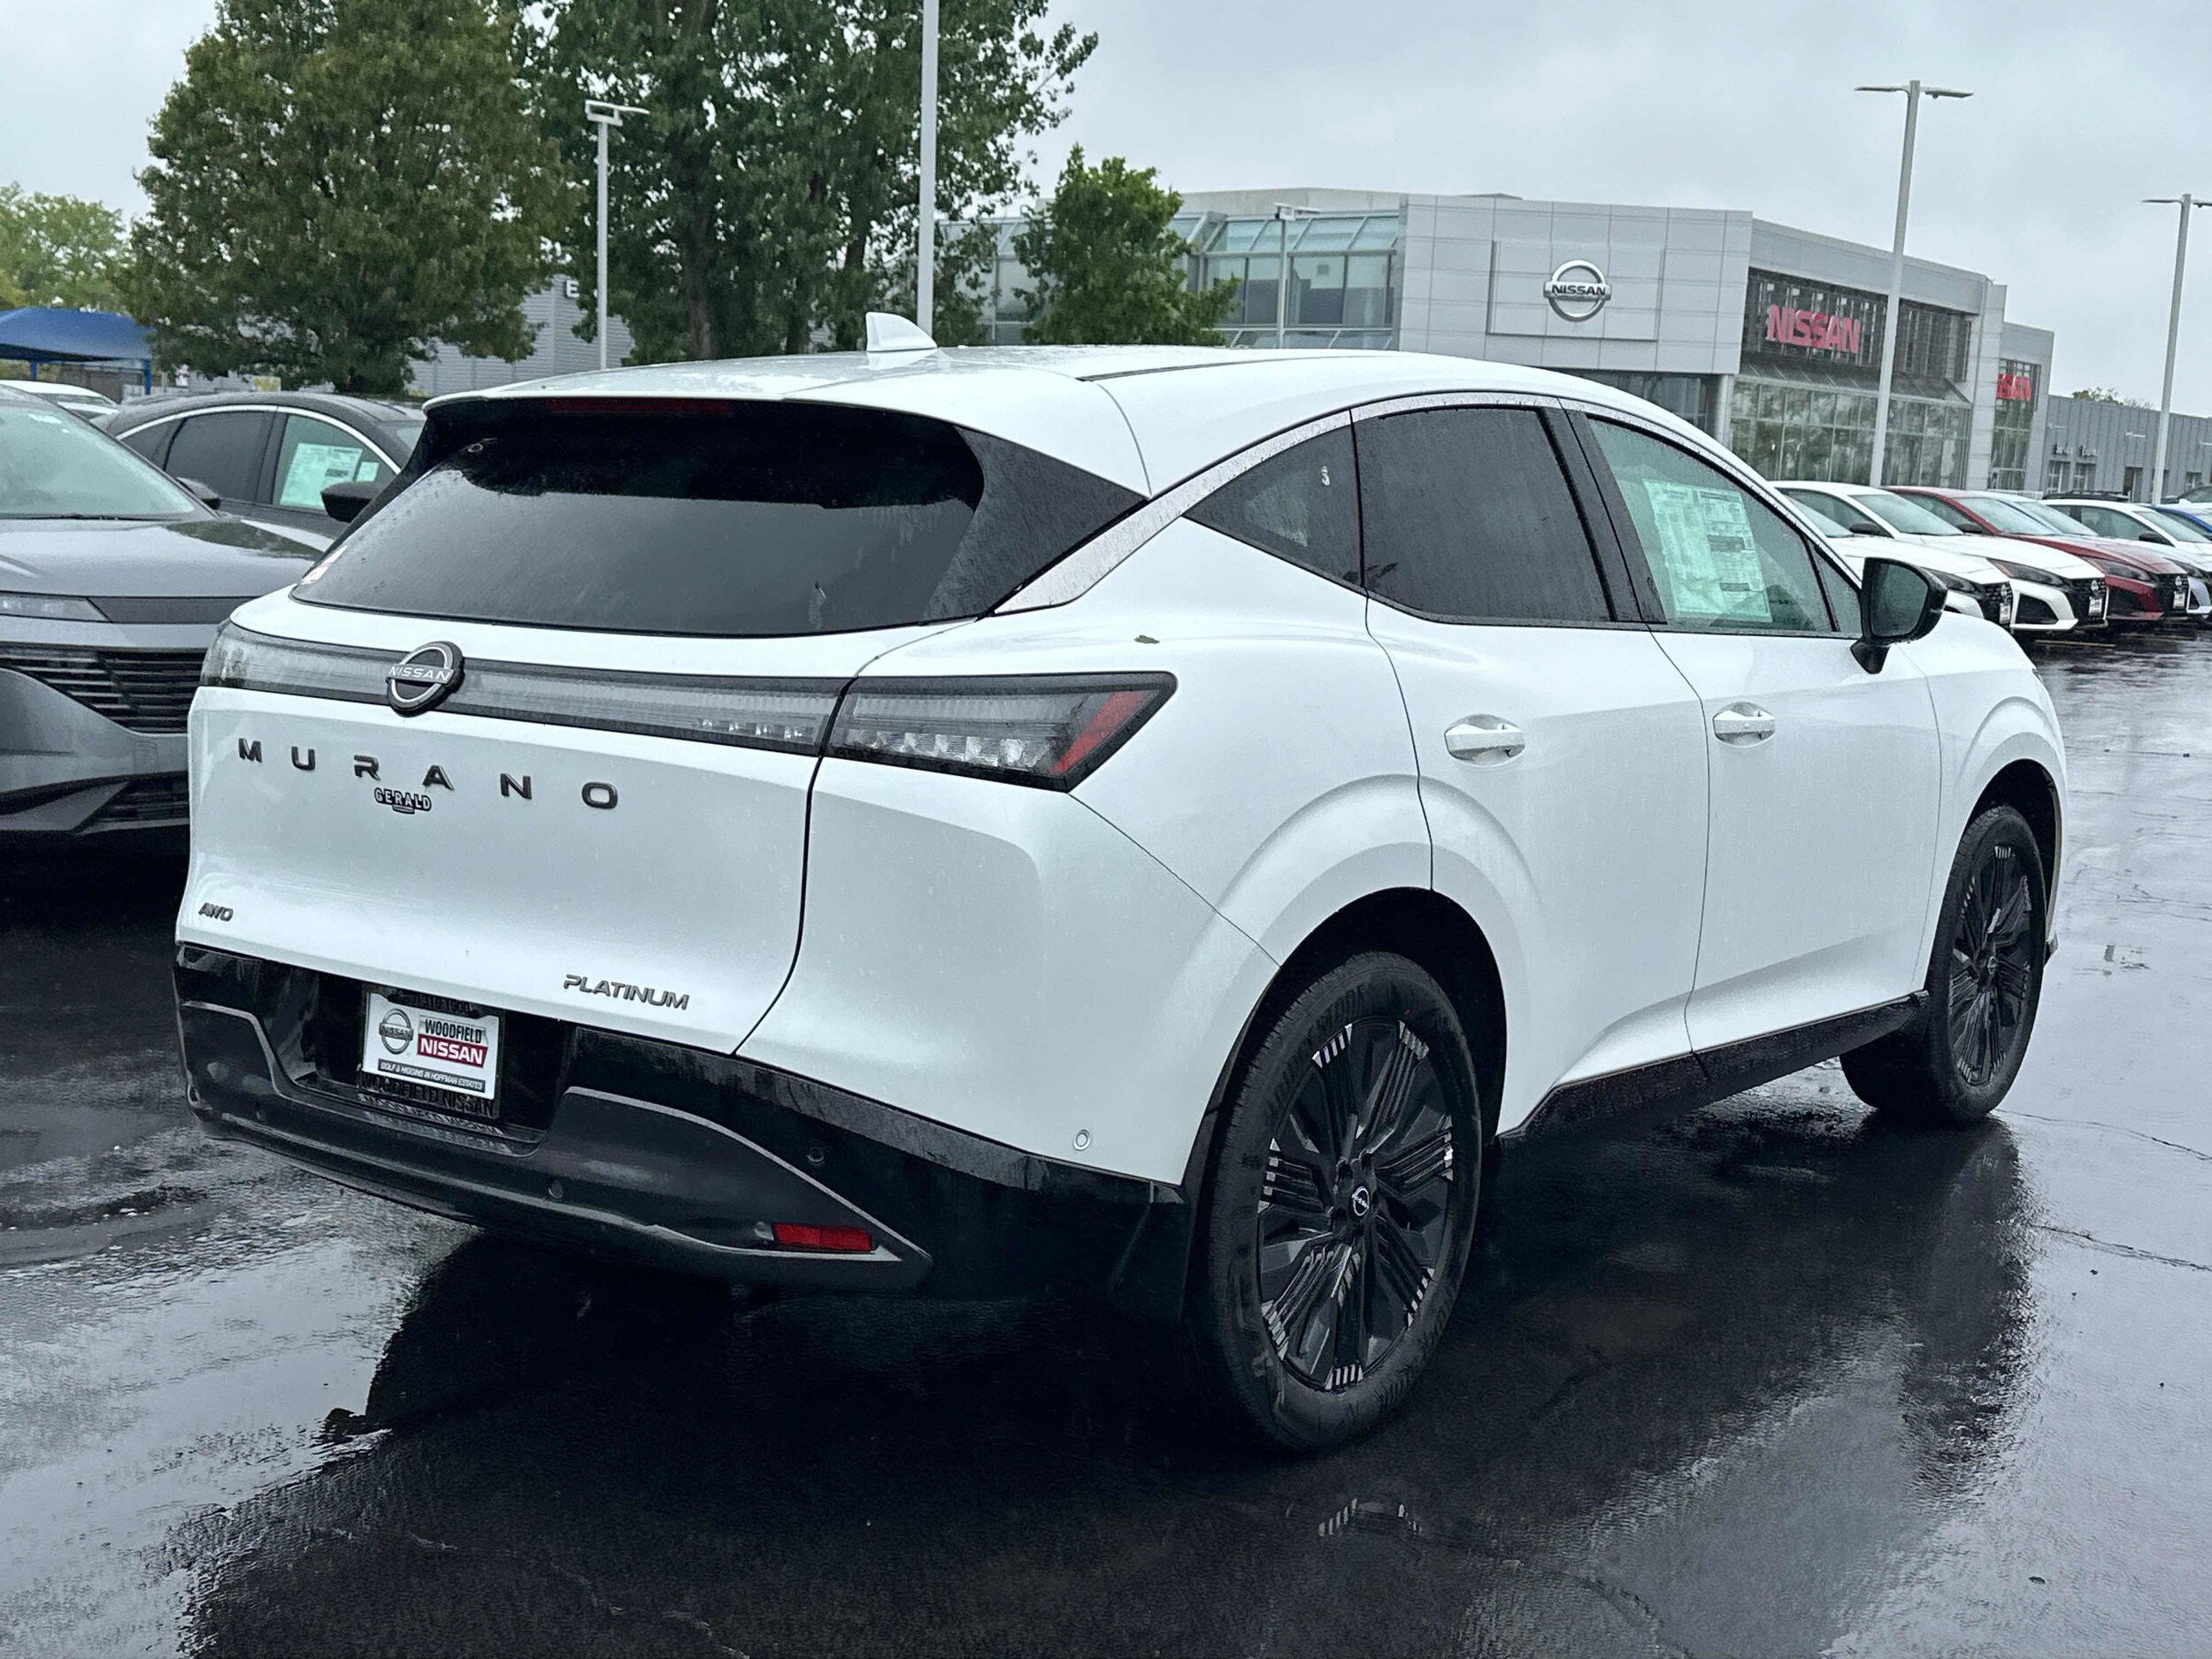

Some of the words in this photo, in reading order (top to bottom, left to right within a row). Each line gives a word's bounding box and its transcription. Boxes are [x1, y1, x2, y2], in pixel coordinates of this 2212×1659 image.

[1552, 284, 1606, 296] NISSAN
[1765, 303, 1861, 354] NISSAN
[389, 666, 450, 682] NISSAN
[238, 737, 619, 810] MURANO
[374, 787, 432, 811] GERALD
[197, 902, 234, 922] AWD
[563, 973, 690, 1010] PLATINUM
[425, 1018, 482, 1044] WOODFIELD
[420, 1038, 483, 1064] NISSAN
